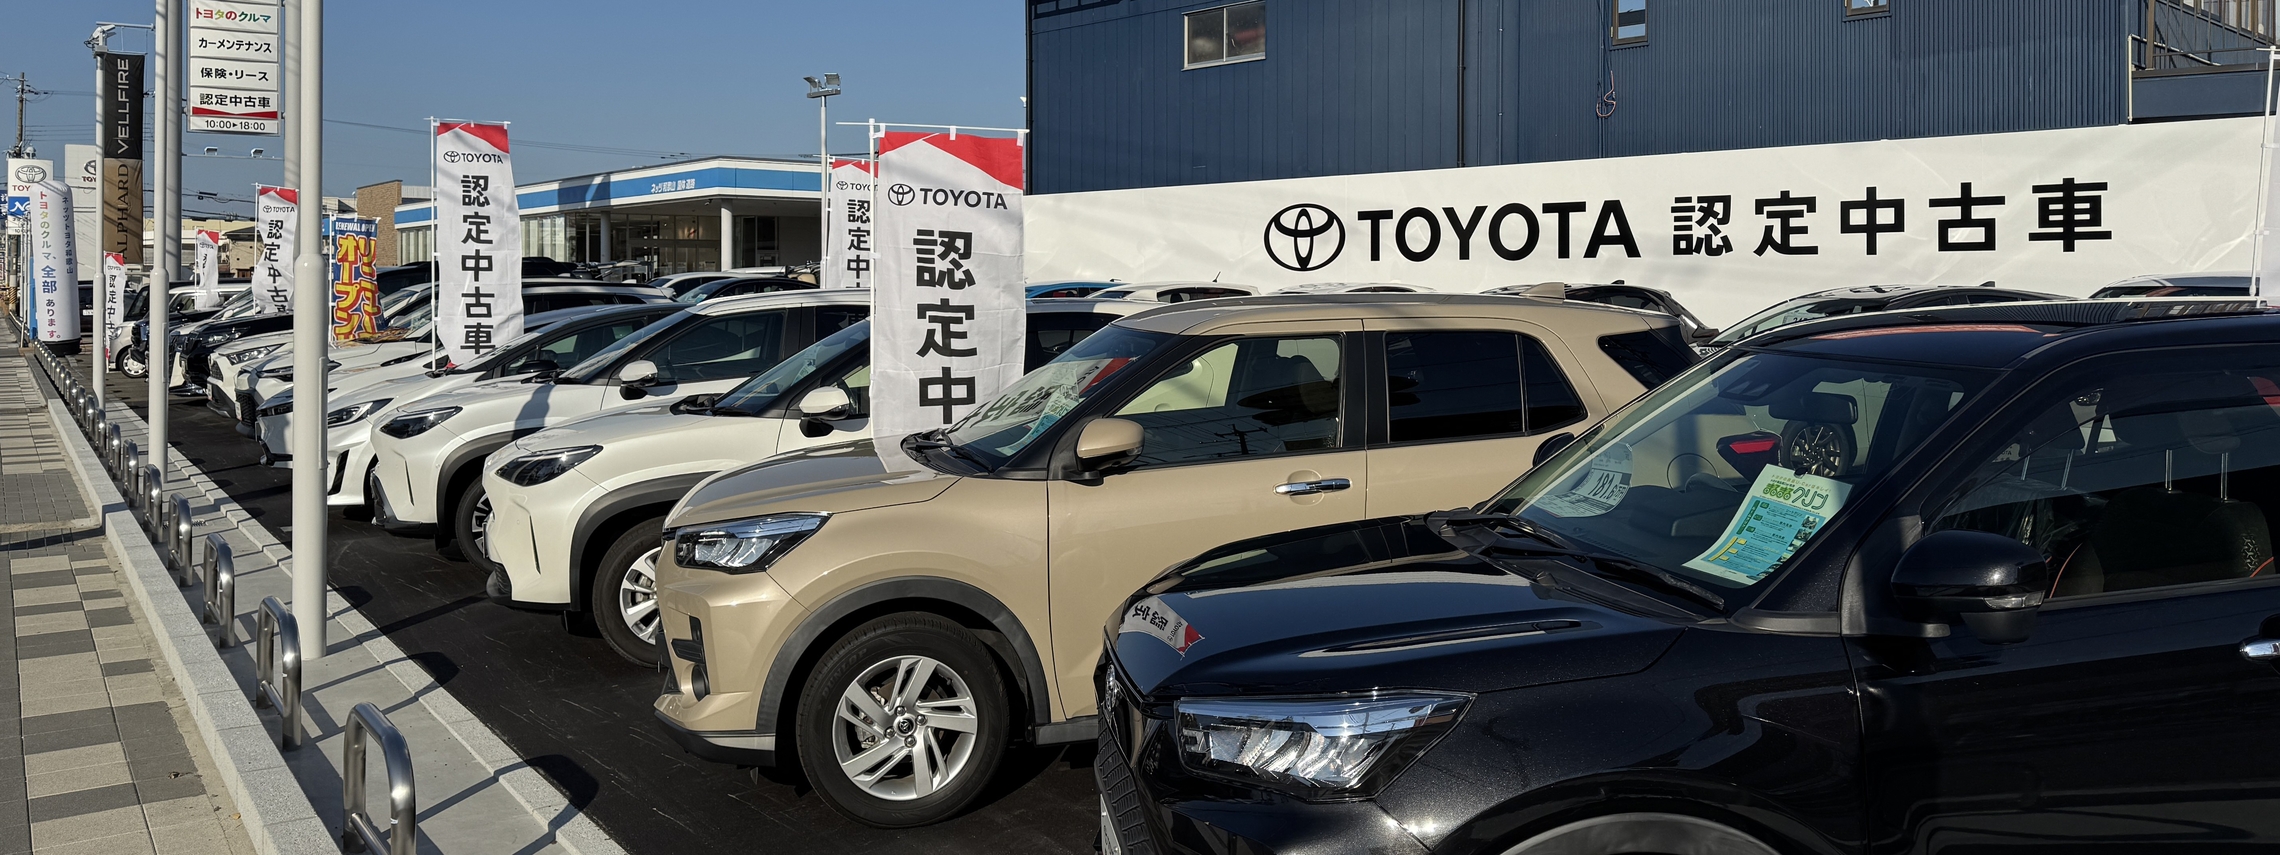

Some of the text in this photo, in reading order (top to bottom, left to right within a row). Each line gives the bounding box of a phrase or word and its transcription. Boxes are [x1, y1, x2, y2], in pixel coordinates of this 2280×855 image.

[195, 7, 271, 23] トヨタのクルマ
[198, 37, 272, 54] カーメンテナンス
[200, 67, 269, 82] 保険・リース
[117, 58, 129, 154] VELLFIRE
[199, 93, 271, 109] 認定中古車
[205, 120, 266, 131] 10:00 18:00
[461, 153, 504, 165] TOYOTA
[12, 184, 31, 192] TOY
[919, 187, 1009, 211] TOYOTA
[272, 206, 296, 214] TOYOTA
[1669, 176, 2114, 258] 認定中古車
[845, 199, 871, 288] 認定中
[1357, 199, 1642, 263] TOYOTA
[460, 174, 496, 355] 認定中古車
[335, 234, 361, 340] オープン
[358, 237, 380, 338] リニュー
[912, 228, 978, 425] 認定中
[821, 648, 868, 698] DUNLOP
